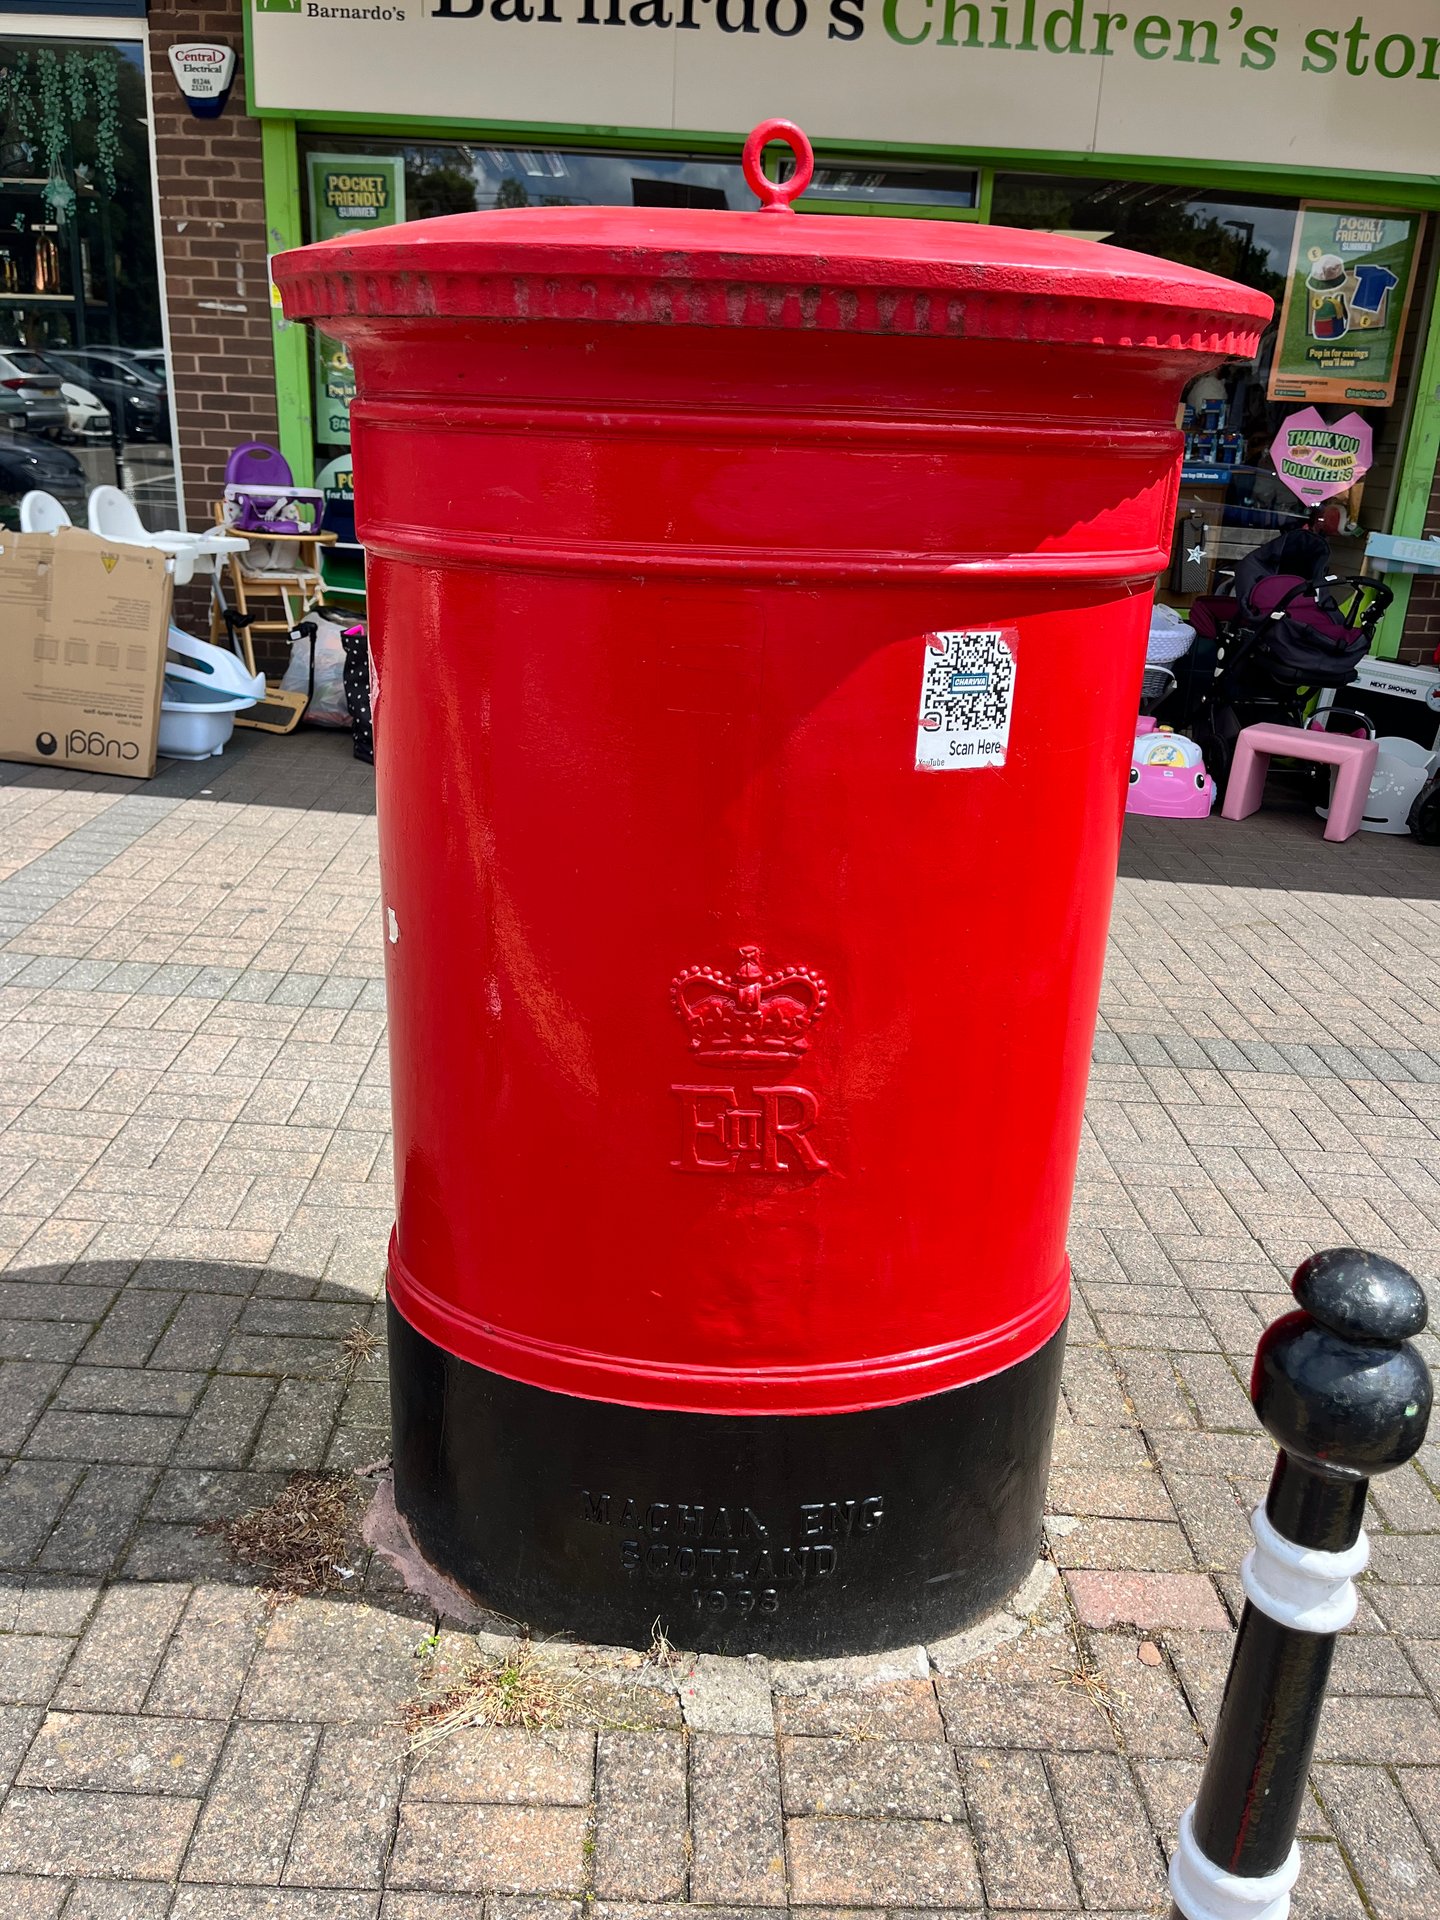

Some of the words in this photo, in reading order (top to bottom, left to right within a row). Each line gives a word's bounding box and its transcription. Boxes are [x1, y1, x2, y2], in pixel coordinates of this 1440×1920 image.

[306, 2, 406, 21] Barnardo's
[431, 0, 865, 41] arnardos
[881, 0, 1279, 71] Children's
[175, 50, 216, 62] Central
[183, 64, 222, 73] Electrical
[328, 175, 384, 192] POCKET
[327, 191, 387, 207] FRIENDLY
[338, 207, 377, 218] SUMMER
[1339, 217, 1384, 232] POCKET
[1335, 230, 1383, 243] FRIENDLY
[1288, 431, 1332, 447] THANK
[1334, 434, 1360, 453] YOU
[1315, 455, 1353, 467] AMAZING
[1282, 459, 1354, 481] VOLUNTEERS
[1369, 680, 1387, 689] NEXT
[1387, 685, 1418, 696] SHOWING
[949, 740, 974, 756] Scan
[977, 739, 1001, 755] Here
[800, 1495, 884, 1535] ENG
[620, 1540, 839, 1580] SCOTLAND
